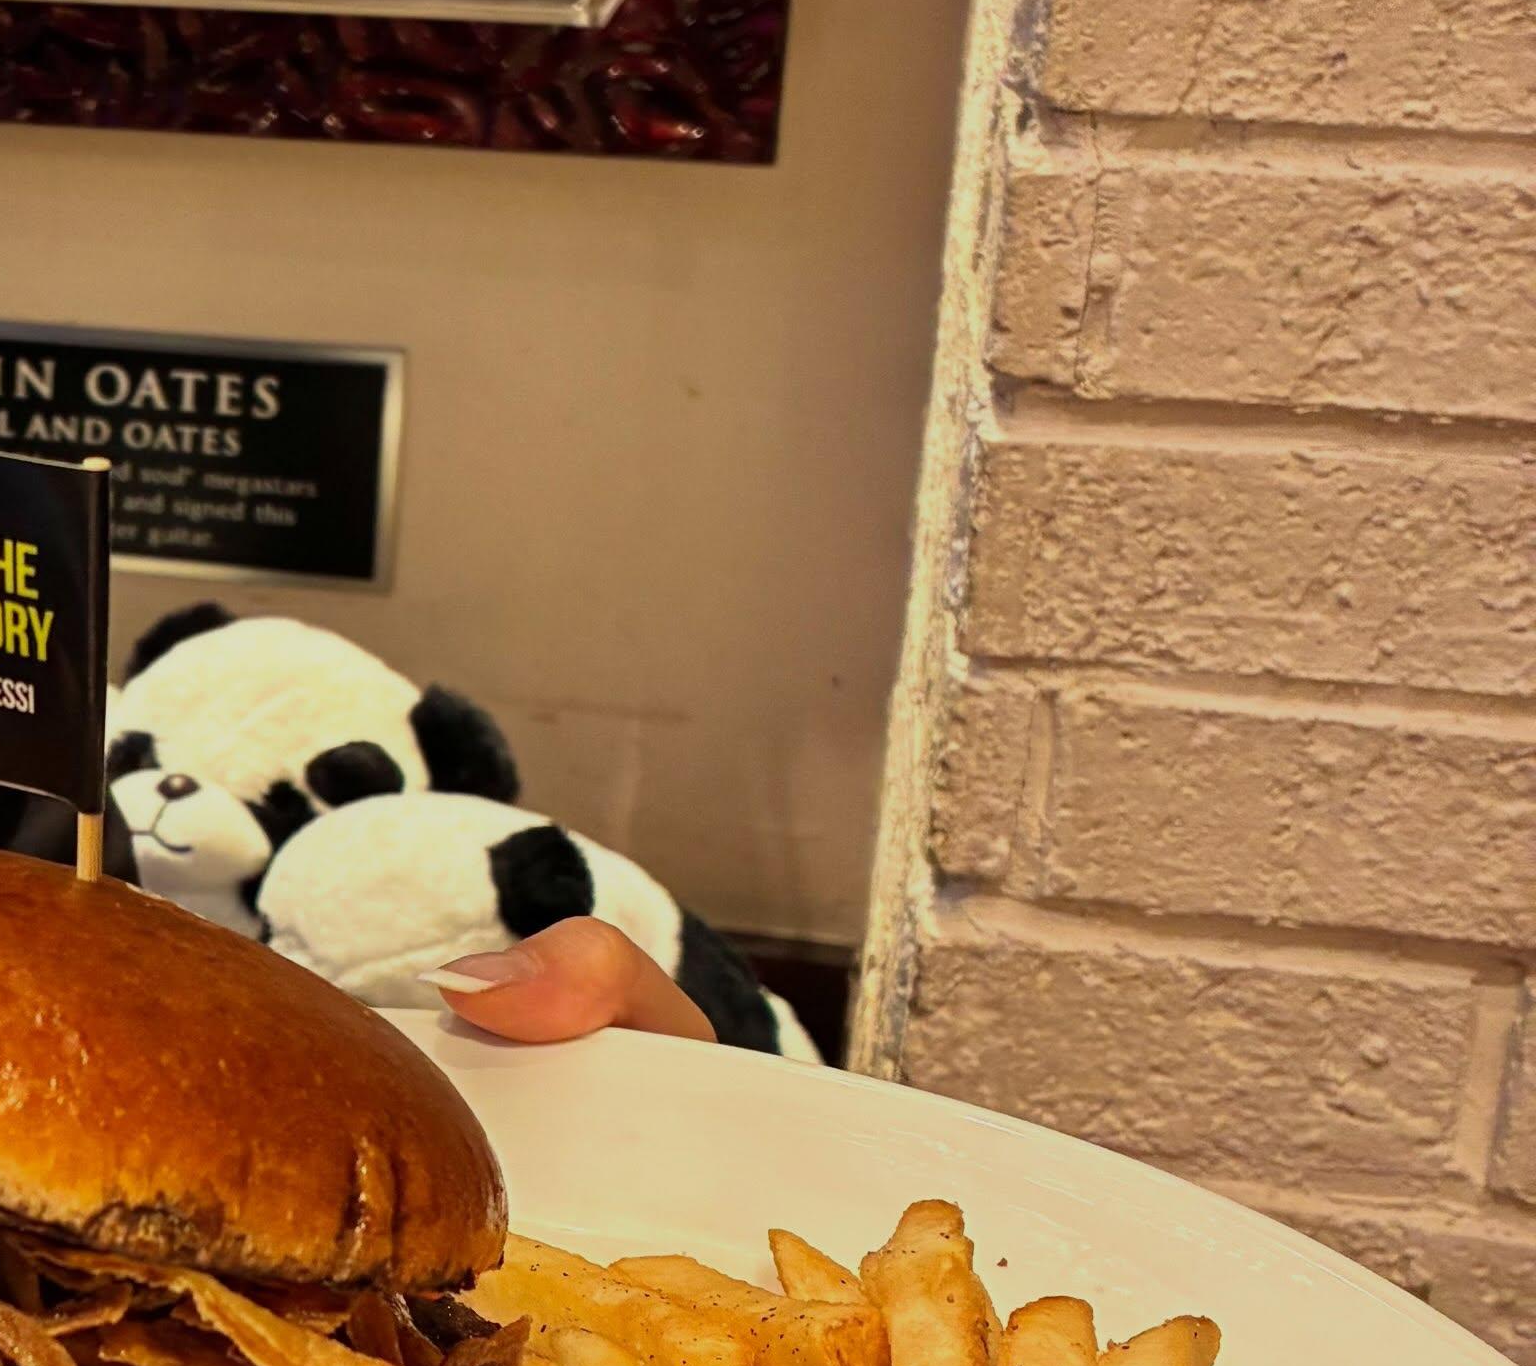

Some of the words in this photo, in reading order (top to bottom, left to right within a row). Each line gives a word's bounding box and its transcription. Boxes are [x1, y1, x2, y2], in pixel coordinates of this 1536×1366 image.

[84, 364, 282, 420] OATES
[24, 413, 111, 447] AND
[122, 418, 242, 457] OATES
[202, 472, 319, 499] megastars
[122, 493, 166, 515] and
[171, 497, 247, 523] signed
[254, 503, 298, 527] this
